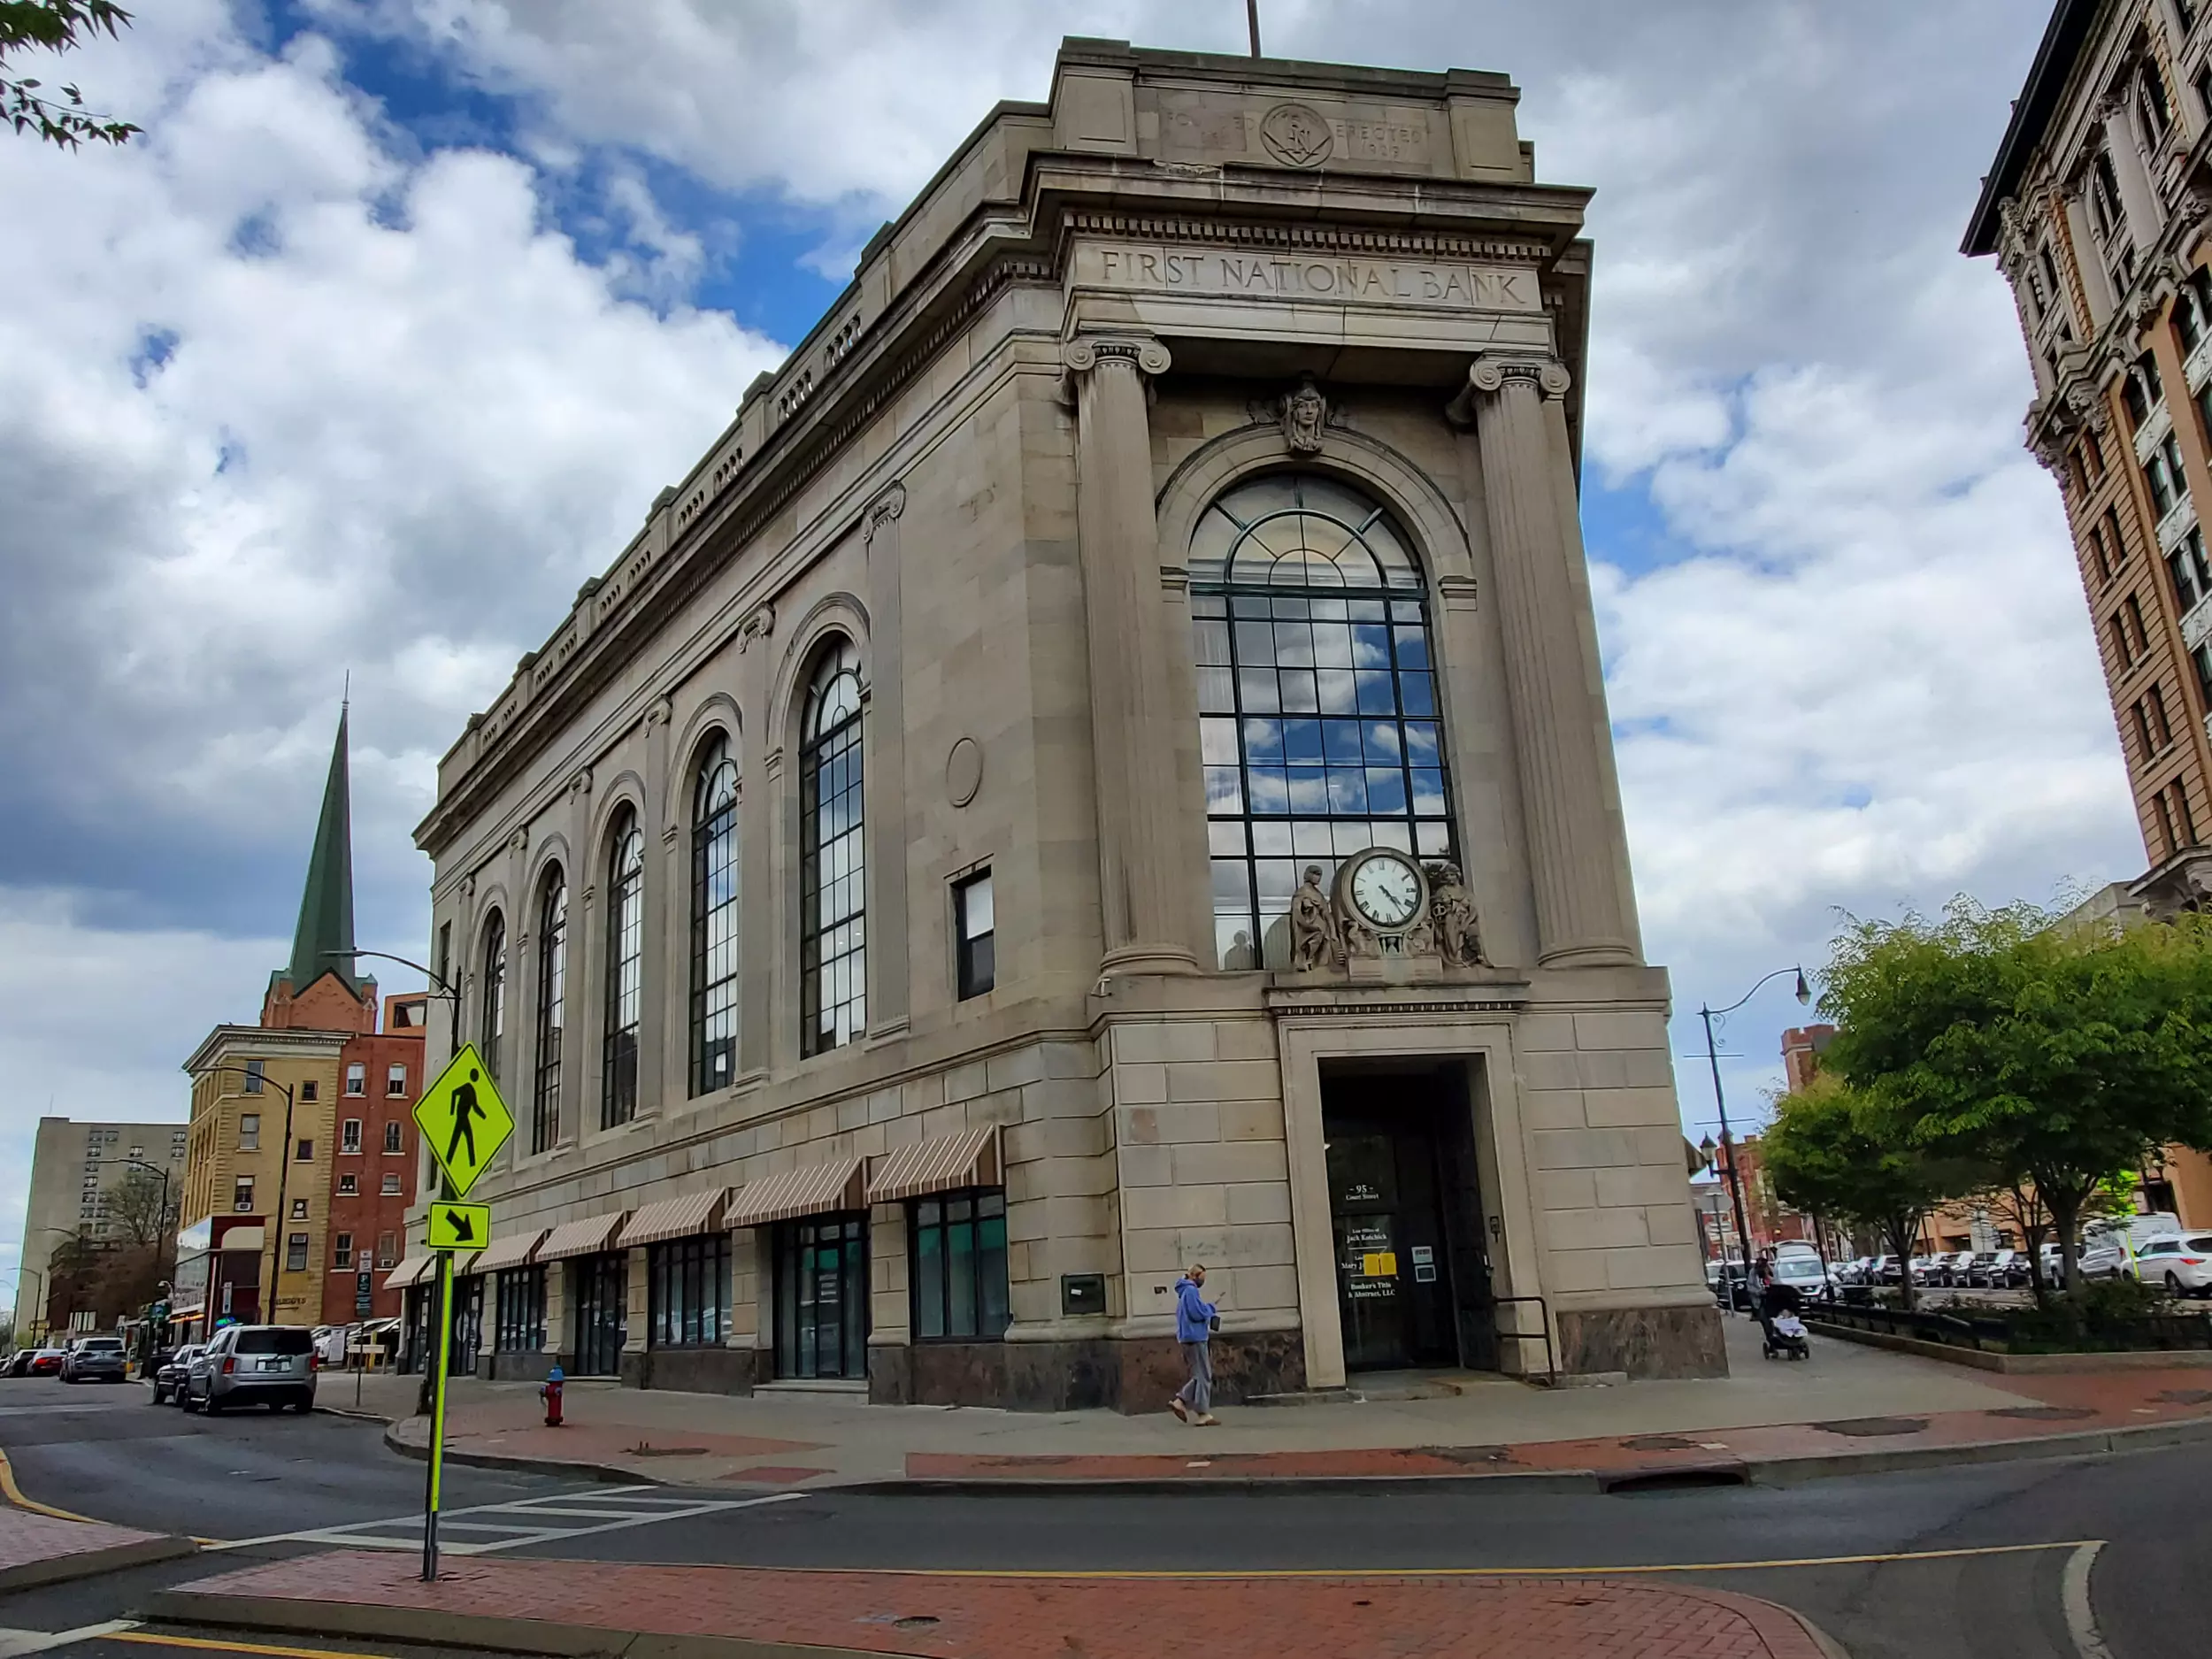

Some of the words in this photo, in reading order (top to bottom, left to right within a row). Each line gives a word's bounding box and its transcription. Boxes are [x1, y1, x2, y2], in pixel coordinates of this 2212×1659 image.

[1335, 124, 1422, 144] ERECTED
[1101, 250, 1204, 286] FIRST
[1220, 258, 1412, 298] NATIONAL
[1419, 270, 1527, 304] BANK
[1356, 1184, 1368, 1194] 95
[1340, 1262, 1357, 1271] Mary
[1382, 1288, 1396, 1297] LLC
